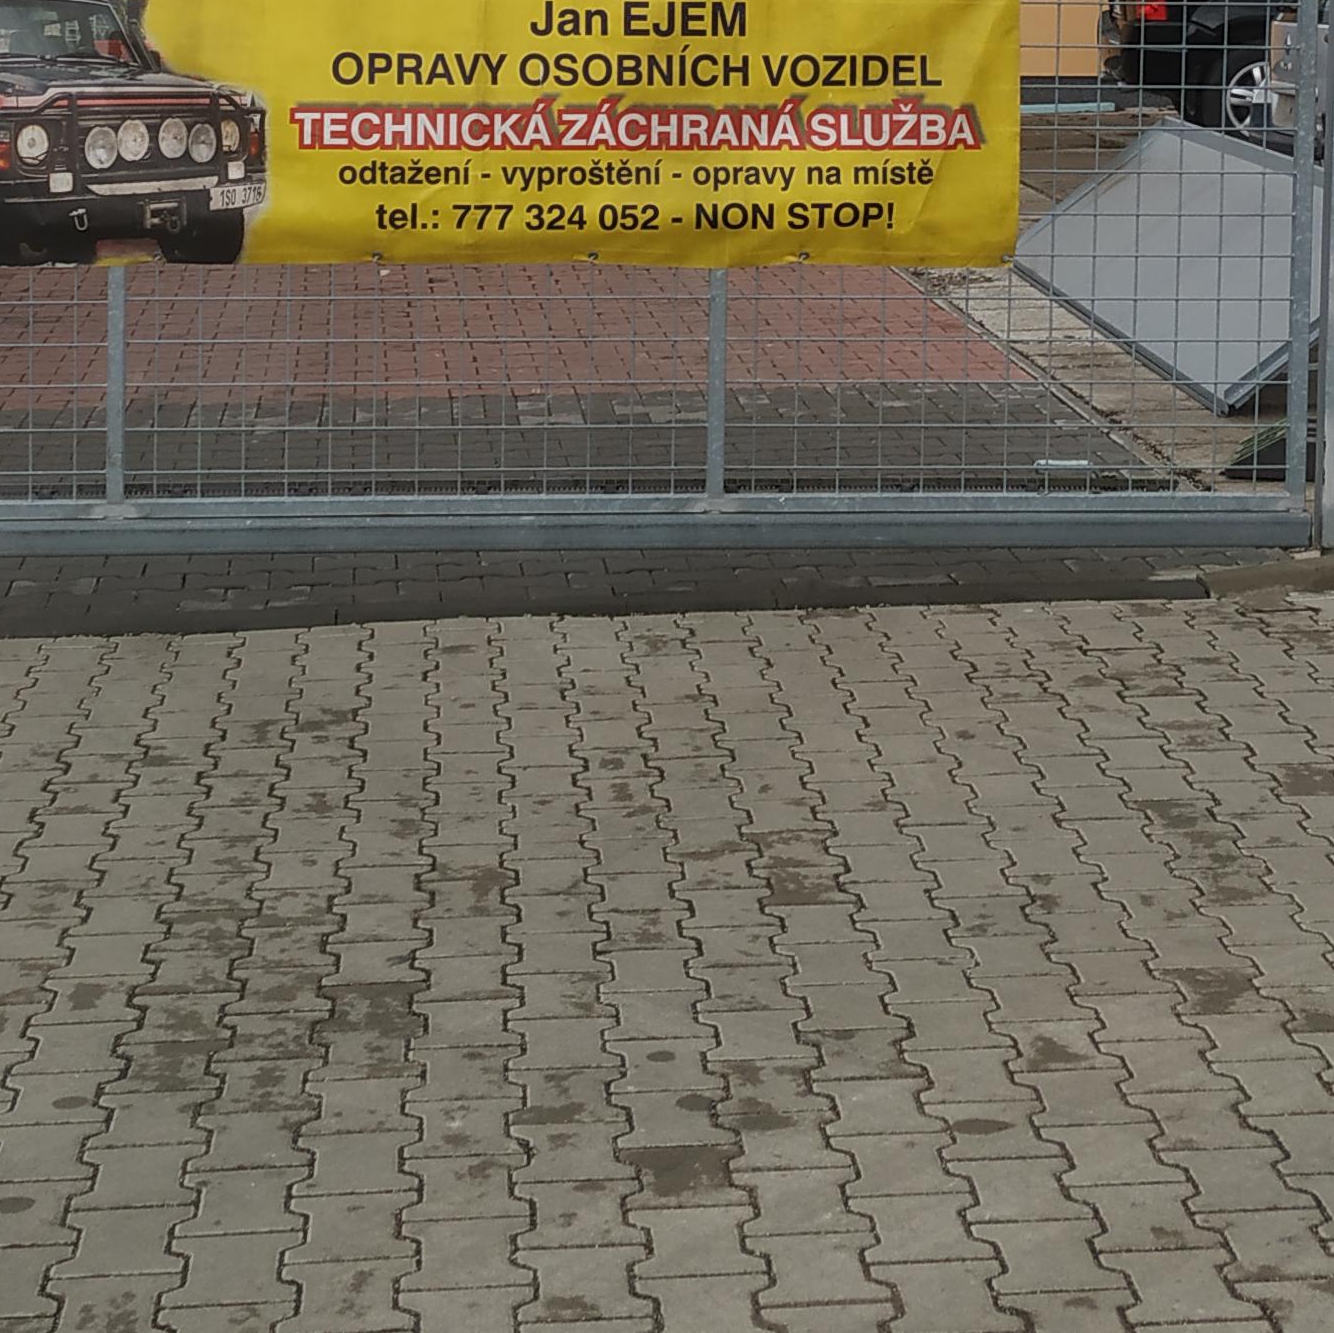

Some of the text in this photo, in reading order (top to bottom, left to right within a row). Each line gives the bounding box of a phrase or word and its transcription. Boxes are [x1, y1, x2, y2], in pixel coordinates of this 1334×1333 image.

[530, 1, 747, 37] Jan EJEM
[331, 45, 943, 87] OPRAVY OSOBNÍCH VOZIDEL
[293, 101, 976, 148] TECHNICKÁ ZÁCHRANÁ SLUŽBA
[337, 158, 472, 186] odtažení
[503, 158, 661, 192] vyproštění
[692, 166, 794, 192] opravy
[807, 166, 842, 186] na
[853, 158, 935, 186] místě
[375, 203, 440, 231] tel.:
[452, 203, 514, 231] 777
[524, 203, 587, 231] 324
[597, 203, 660, 231] 052
[694, 202, 775, 231] NON
[786, 201, 895, 230] STOP!
